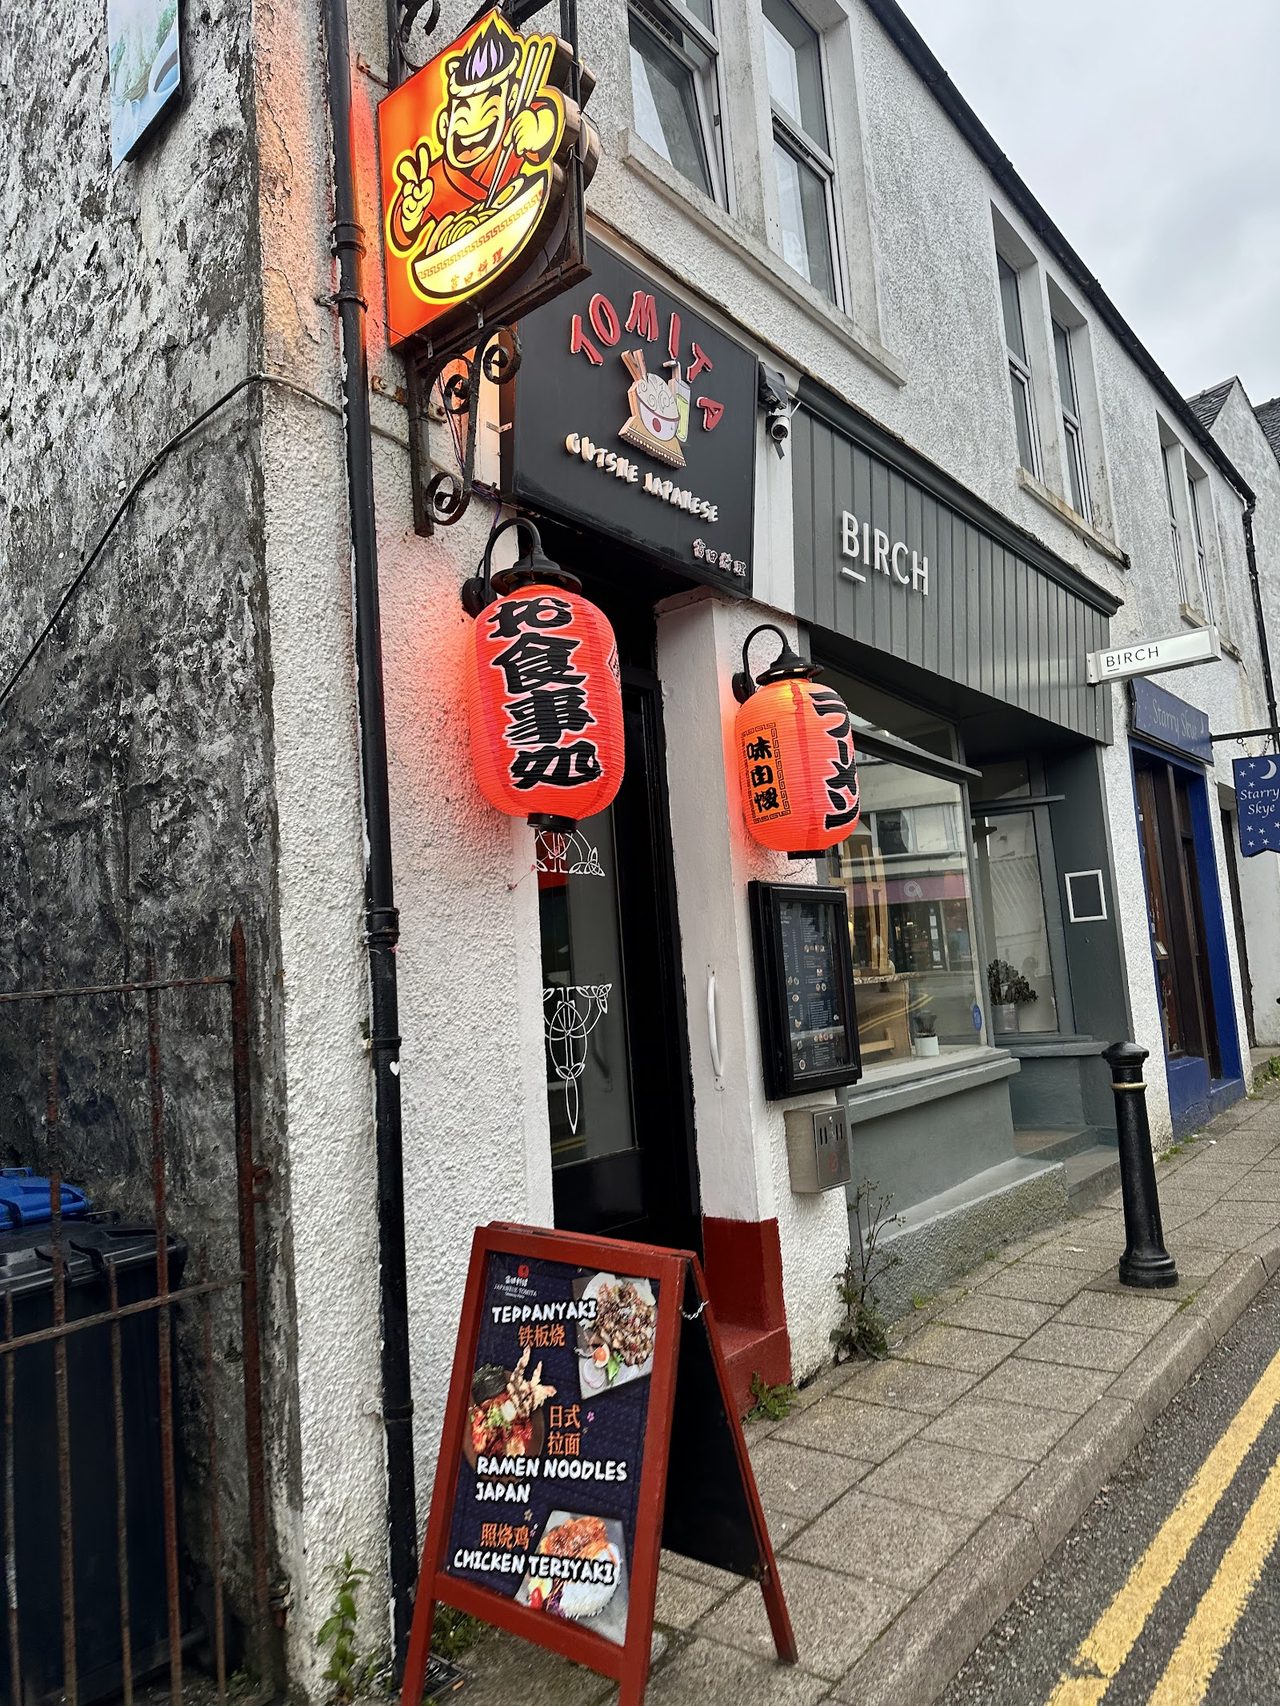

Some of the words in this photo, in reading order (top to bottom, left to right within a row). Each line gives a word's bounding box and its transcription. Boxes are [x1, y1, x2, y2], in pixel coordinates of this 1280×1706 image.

[570, 290, 725, 431] TOMITA
[642, 472, 719, 523] JAPANESE
[842, 510, 929, 596] BIRCH
[1106, 646, 1159, 667] BIRCH
[1152, 698, 1180, 745] Starry
[1240, 788, 1280, 801] Starry
[1247, 800, 1276, 818] Skye
[492, 1299, 597, 1323] TEPPANYAKI
[518, 1323, 565, 1347] 铁板烧
[550, 1405, 581, 1429] 日式
[547, 1432, 581, 1456] 拉面
[477, 1456, 540, 1478] RAMEN
[543, 1458, 628, 1482] NOODLES
[475, 1481, 531, 1503] JAPAN
[480, 1522, 530, 1551] 照烧鸡
[453, 1549, 526, 1574] CHICKEN
[528, 1555, 614, 1583] TERIYAKI
